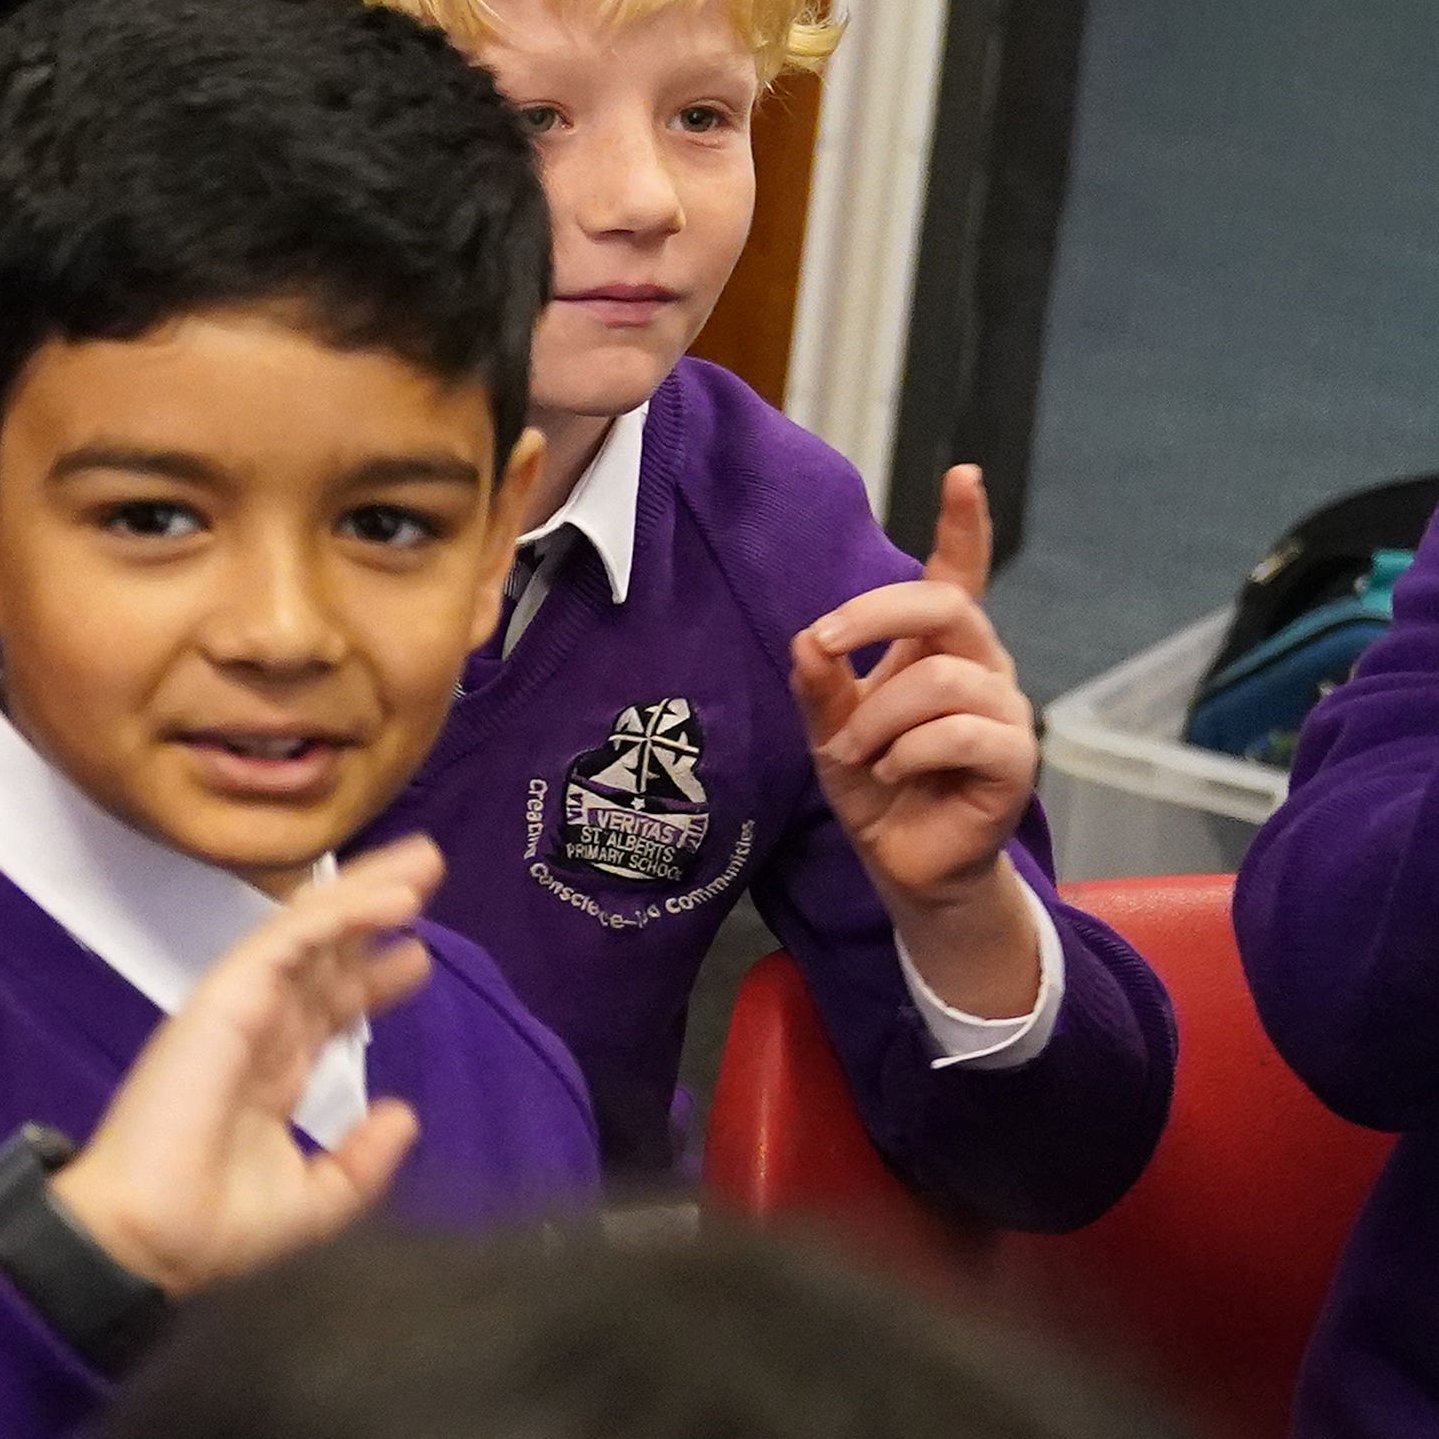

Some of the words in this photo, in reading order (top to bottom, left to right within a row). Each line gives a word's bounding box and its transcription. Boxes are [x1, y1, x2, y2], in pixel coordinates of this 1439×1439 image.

[596, 808, 675, 846] VERITAS
[566, 842, 625, 865] PRIMARY
[605, 829, 677, 863] ALBERTS
